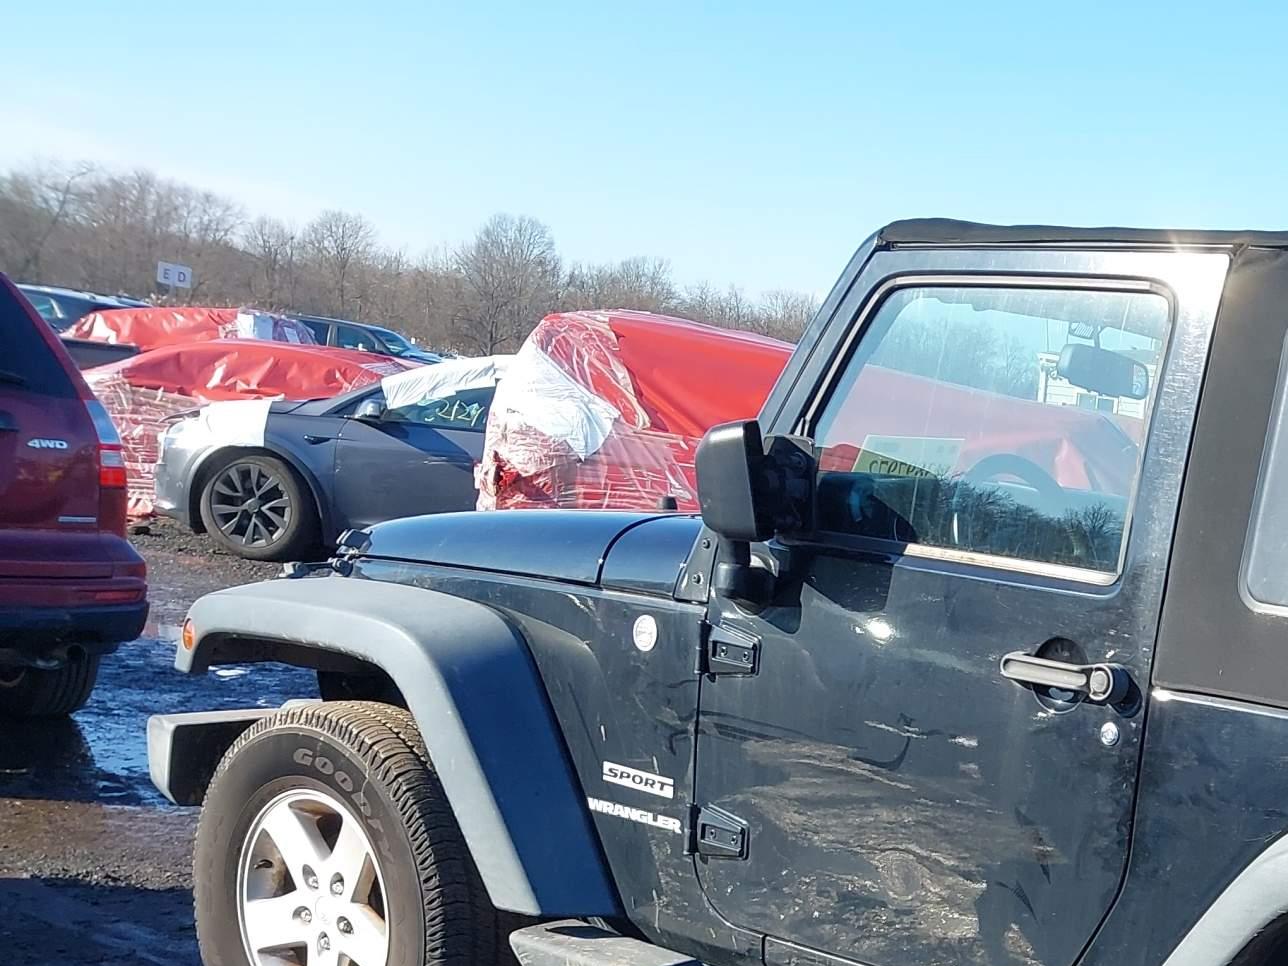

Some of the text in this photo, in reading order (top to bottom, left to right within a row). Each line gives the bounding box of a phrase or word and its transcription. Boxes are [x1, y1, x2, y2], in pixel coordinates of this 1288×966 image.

[177, 271, 186, 283] D
[27, 439, 68, 449] 4WD
[605, 766, 671, 793] SPORT
[586, 797, 683, 834] WRANGLER
